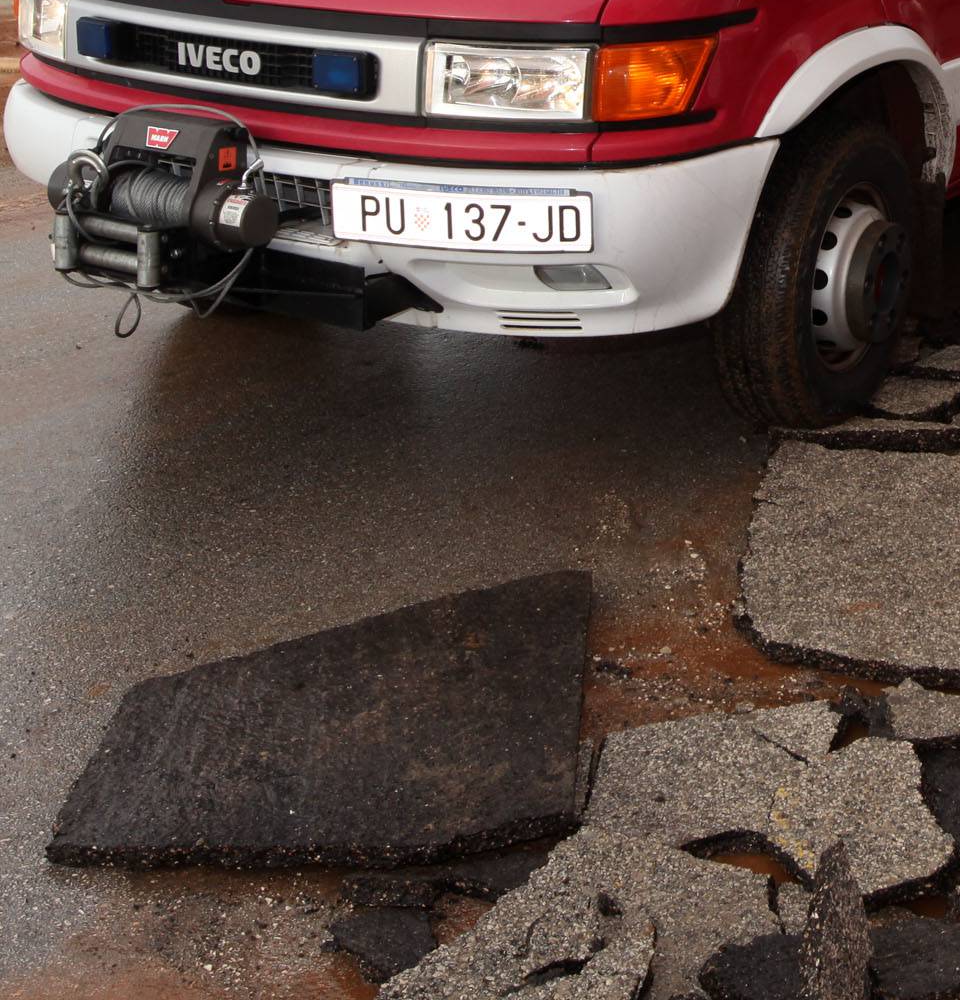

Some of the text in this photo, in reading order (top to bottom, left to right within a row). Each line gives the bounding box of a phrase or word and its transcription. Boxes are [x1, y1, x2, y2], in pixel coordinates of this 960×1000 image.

[177, 42, 261, 76] IVECO
[360, 195, 581, 243] PU 137-JD
